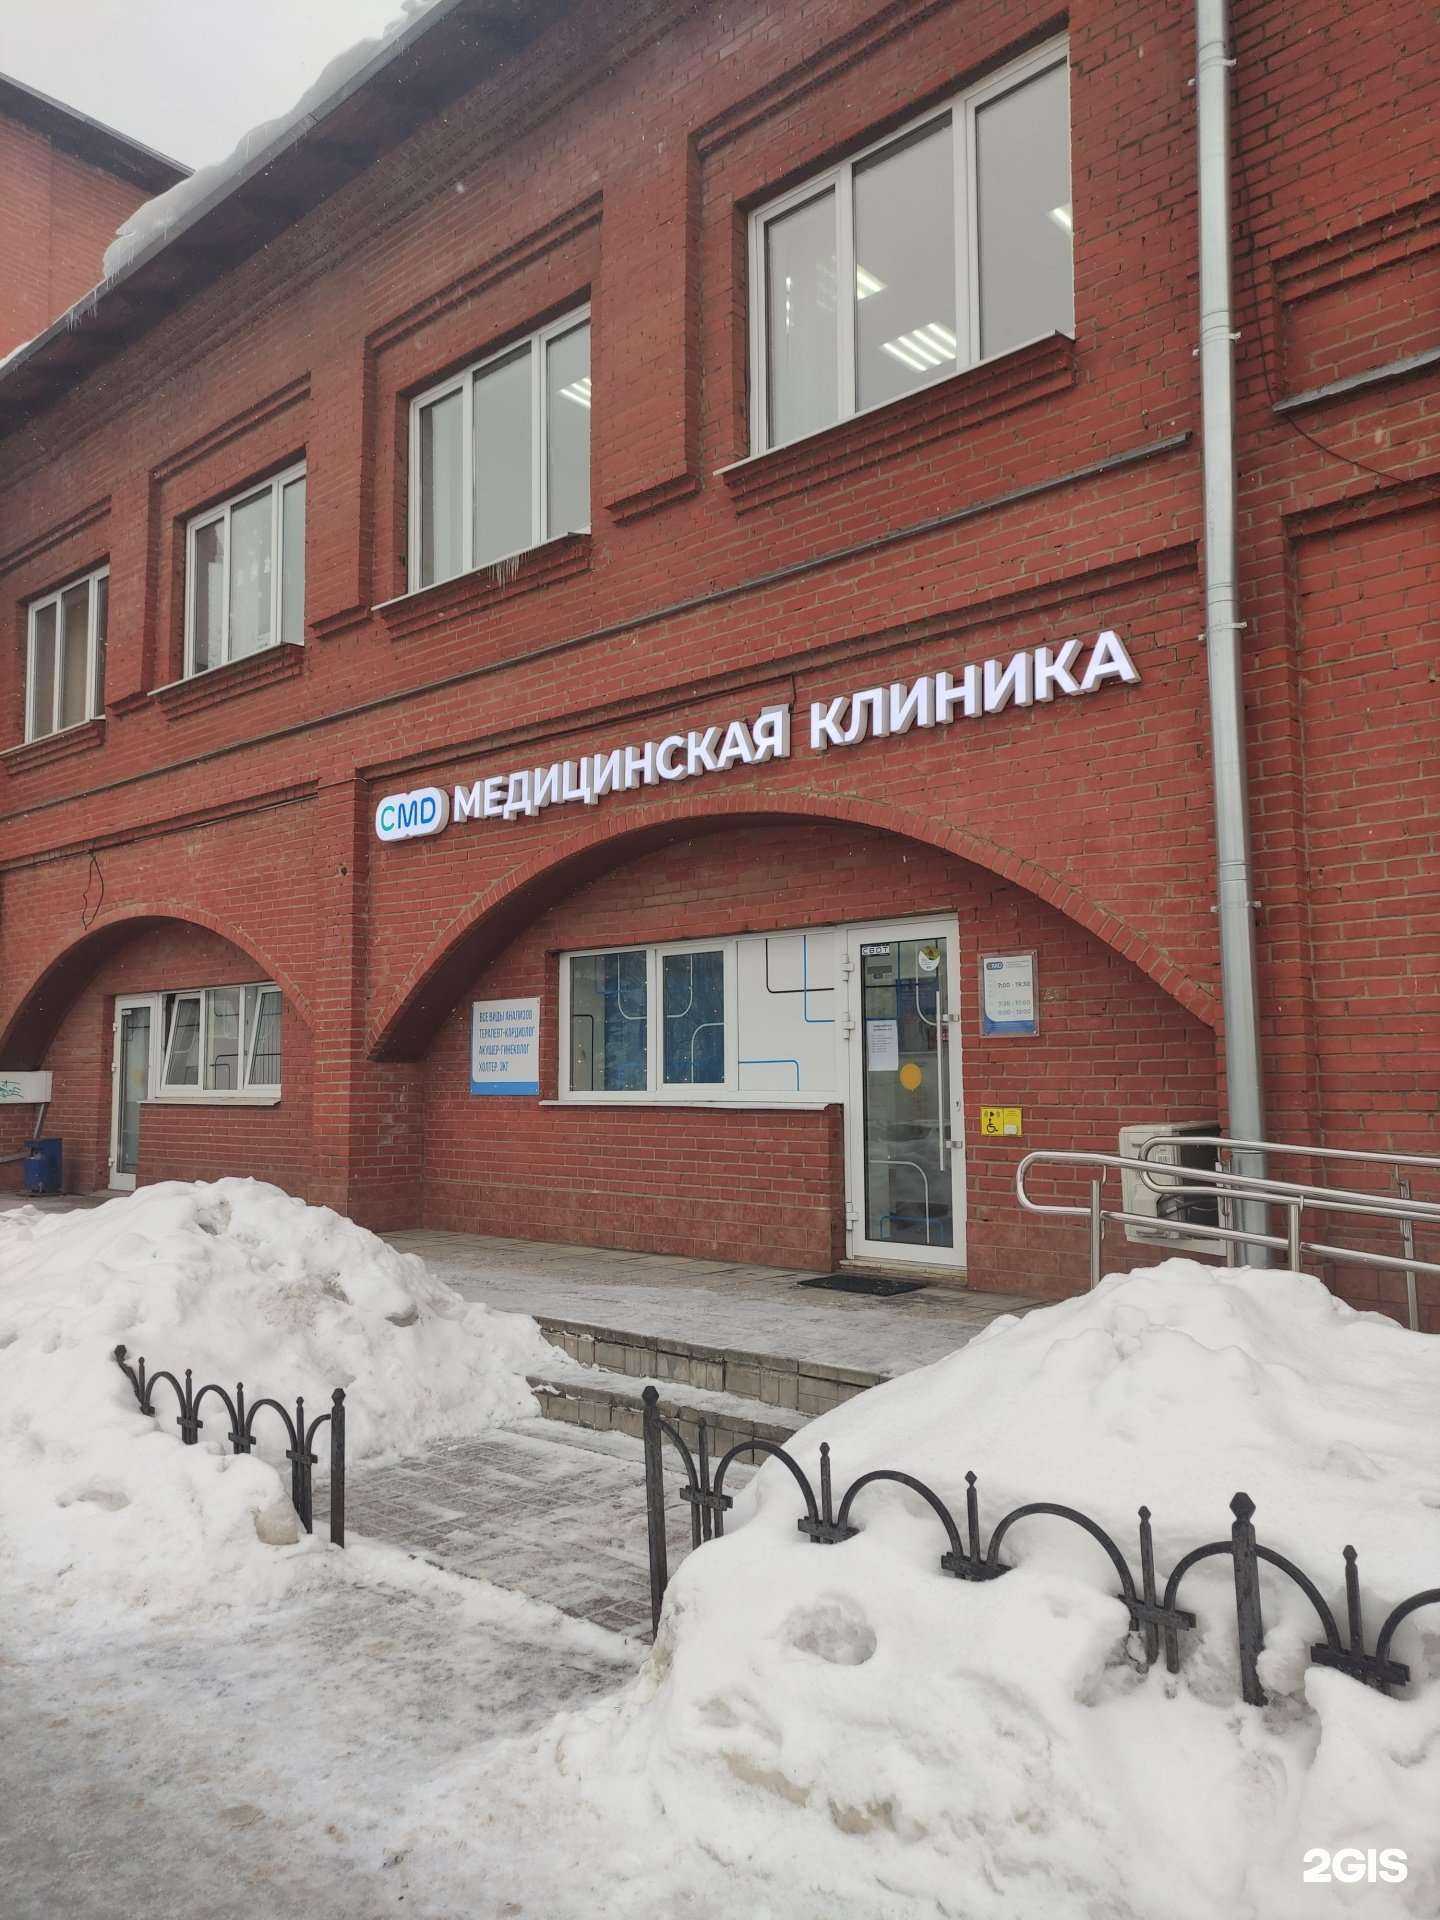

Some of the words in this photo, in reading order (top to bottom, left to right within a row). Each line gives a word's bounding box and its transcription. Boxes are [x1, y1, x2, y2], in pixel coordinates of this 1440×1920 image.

[380, 796, 436, 832] CMD
[453, 704, 791, 823] МЕДИЦИНСКАЯ
[810, 630, 1141, 750] КЛИНИКА
